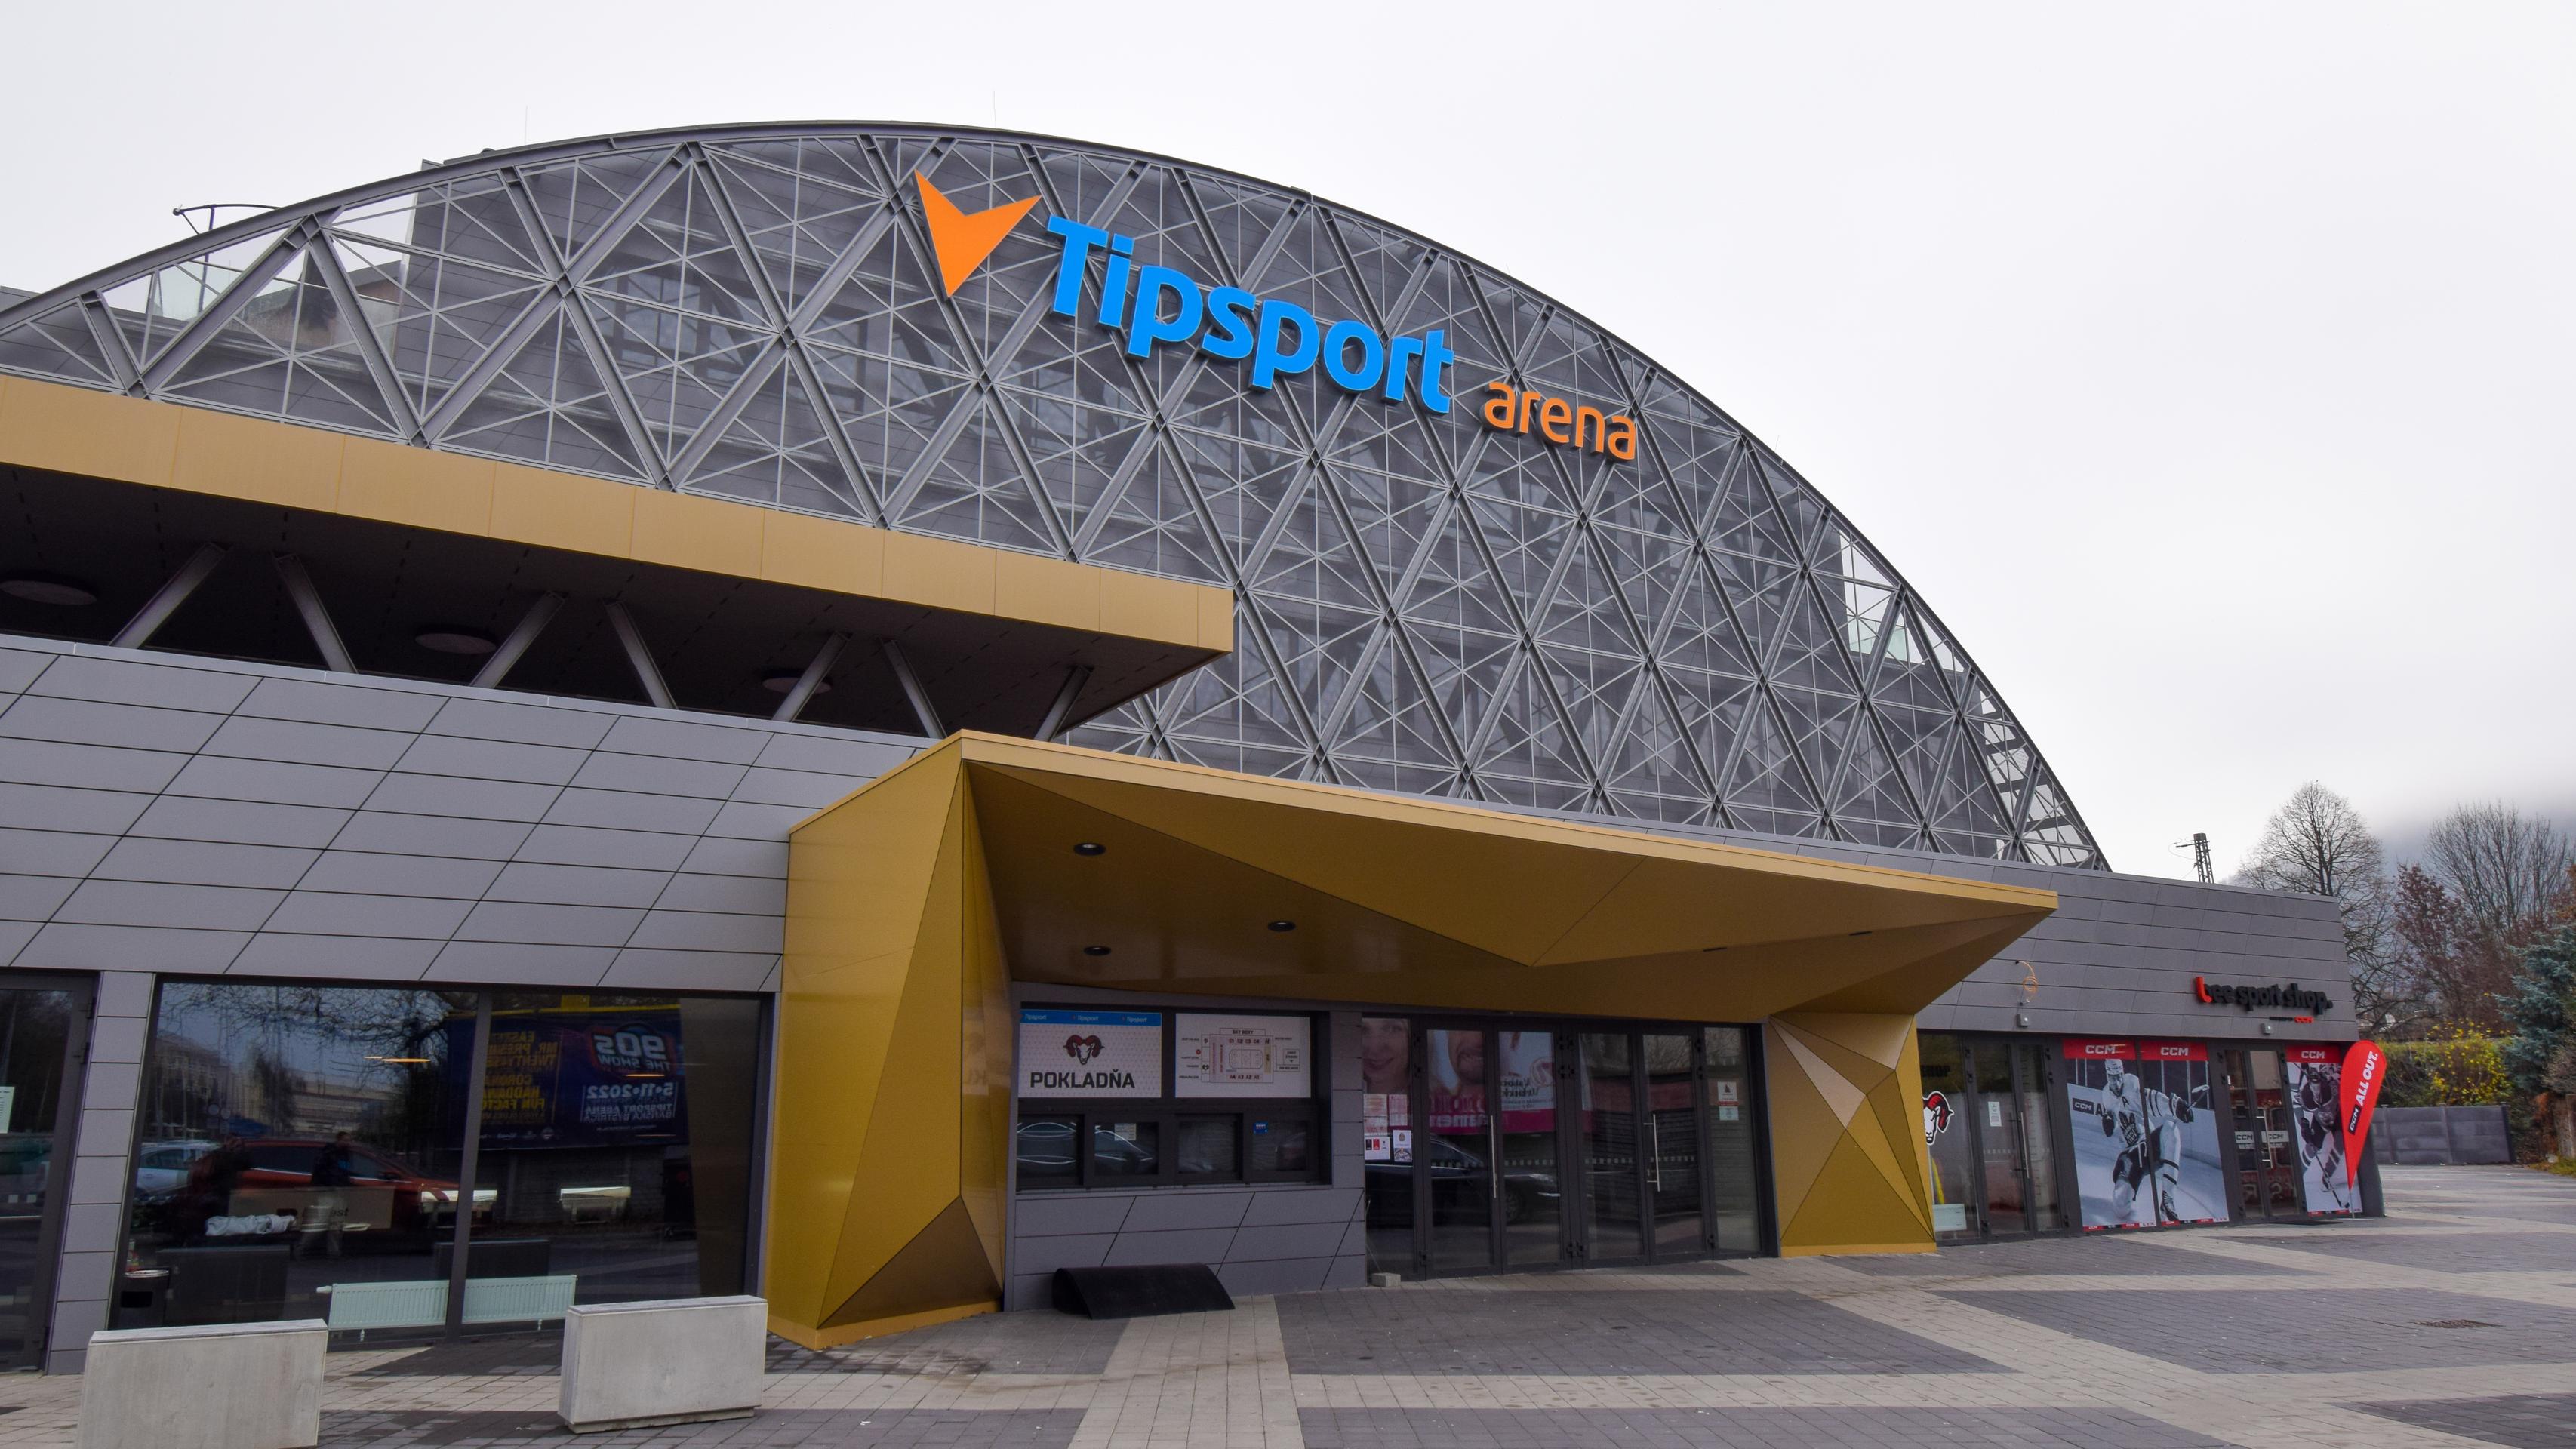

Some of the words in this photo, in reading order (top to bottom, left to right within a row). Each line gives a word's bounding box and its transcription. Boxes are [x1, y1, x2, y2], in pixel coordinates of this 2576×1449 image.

[1046, 214, 1455, 414] Tipsport
[1482, 382, 1636, 462] arena
[2236, 983, 2282, 1012] sport
[2085, 1044, 2116, 1054] CCM
[2160, 1047, 2189, 1056] CCM
[2301, 1051, 2325, 1059] CCM
[2362, 1051, 2379, 1081] OUT.
[1029, 1068, 1136, 1088] POKLADŇA
[2122, 1096, 2129, 1107] A
[2355, 1081, 2370, 1106] ALL
[2074, 1102, 2092, 1110] CCM
[2350, 1107, 2359, 1131] CCM
